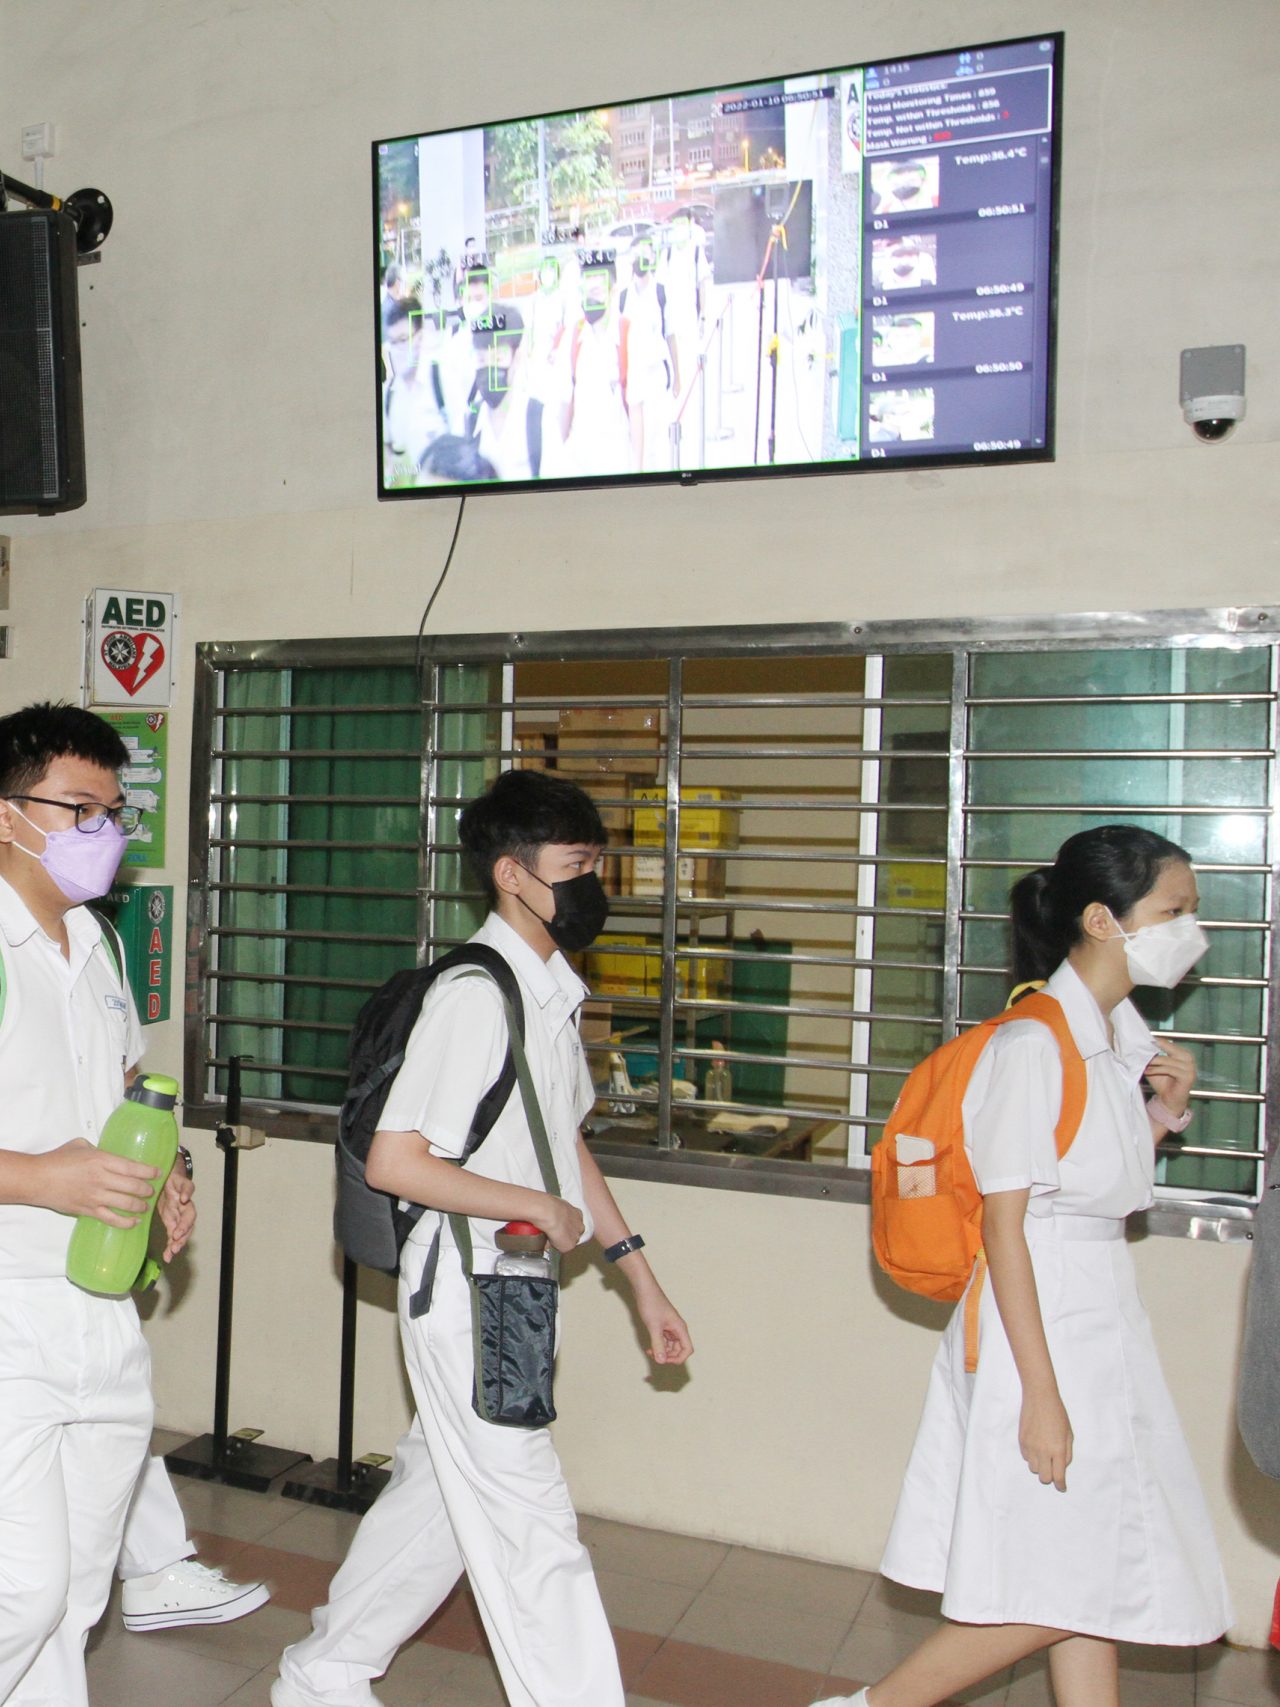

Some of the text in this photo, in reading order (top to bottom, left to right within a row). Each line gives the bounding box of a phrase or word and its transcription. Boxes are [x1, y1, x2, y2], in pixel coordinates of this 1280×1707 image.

[868, 102, 891, 113] Total
[892, 97, 942, 109] Monitoring
[944, 91, 972, 102] Times
[896, 111, 924, 122] within
[926, 103, 976, 117] Thresholds
[896, 124, 913, 134] Not
[915, 120, 943, 131] within
[945, 113, 996, 127] Thresholds
[866, 140, 890, 150] Mask
[890, 135, 927, 147] Warning
[101, 596, 166, 627] AED
[148, 927, 163, 1019] AED
